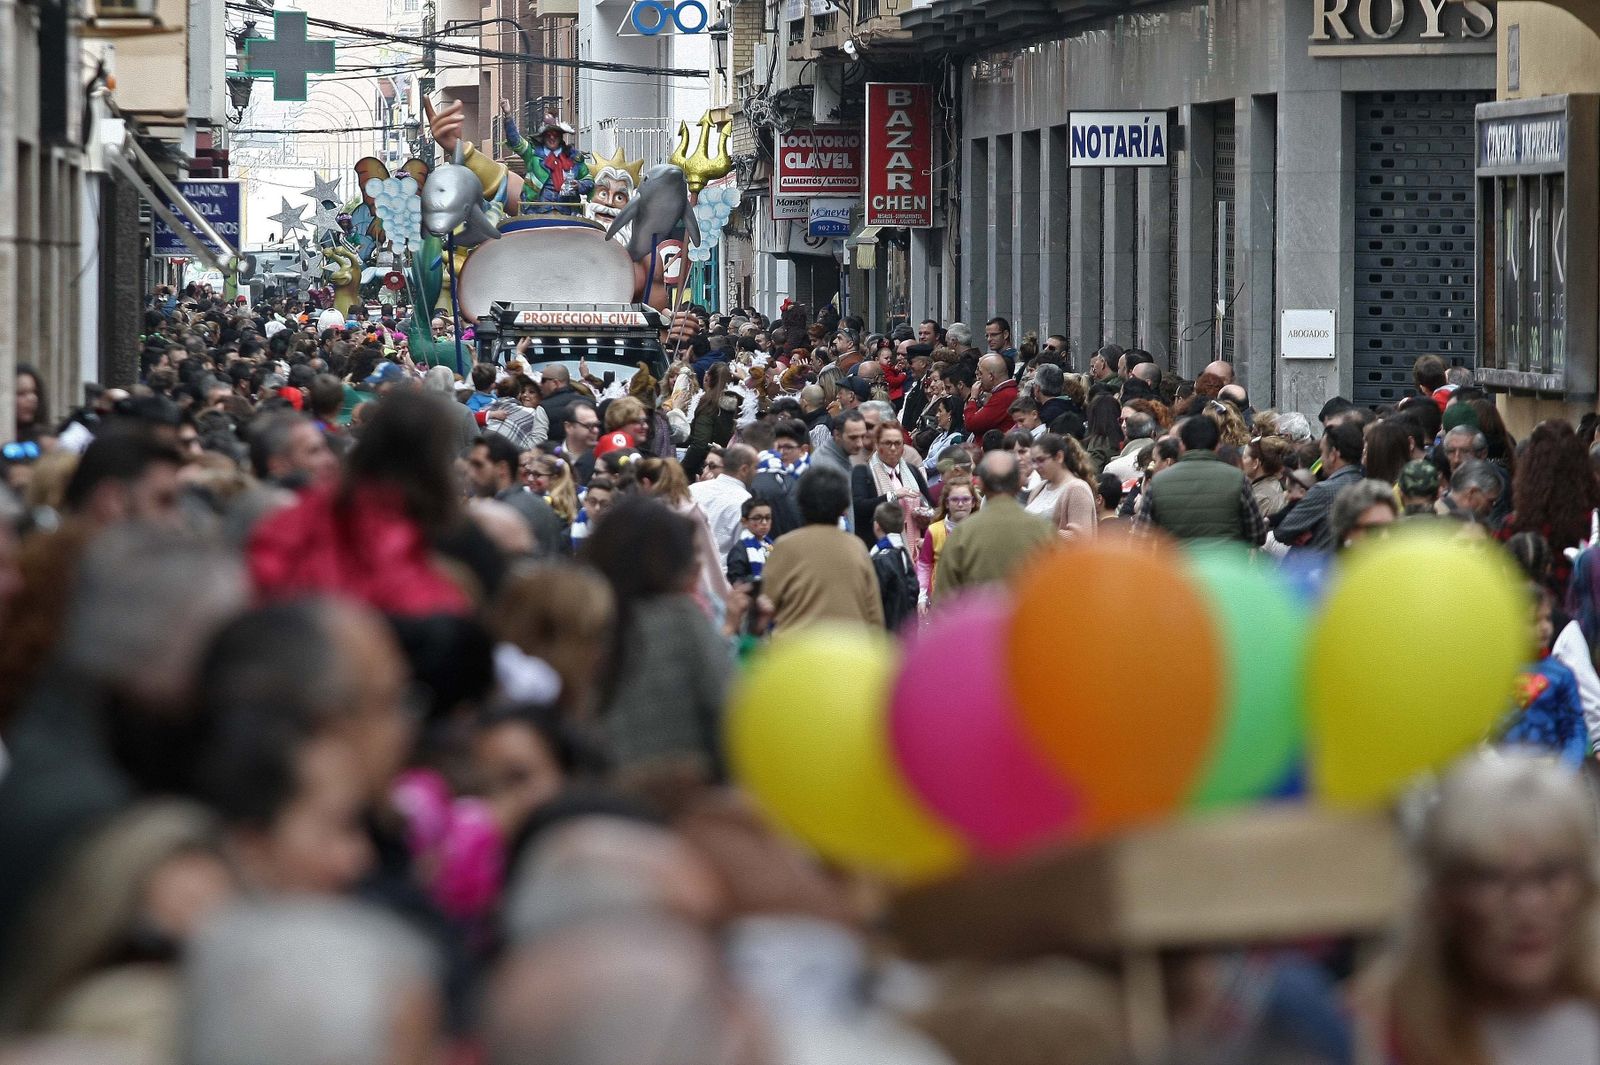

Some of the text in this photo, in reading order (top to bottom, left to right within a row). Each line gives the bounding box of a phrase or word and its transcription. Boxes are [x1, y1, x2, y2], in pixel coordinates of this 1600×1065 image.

[1308, 0, 1494, 40] ROYS
[780, 135, 860, 148] LOCUTORIO
[886, 88, 913, 190] BAZAR
[1071, 116, 1165, 158] NOTARÍA
[1487, 124, 1516, 165] CINEMA
[784, 152, 853, 169] CLAVEL
[183, 184, 228, 197] ALIANZA
[872, 195, 926, 210] CHEN
[523, 312, 640, 326] PROTECCION CIVIL
[1288, 329, 1330, 338] ABOGADOS
